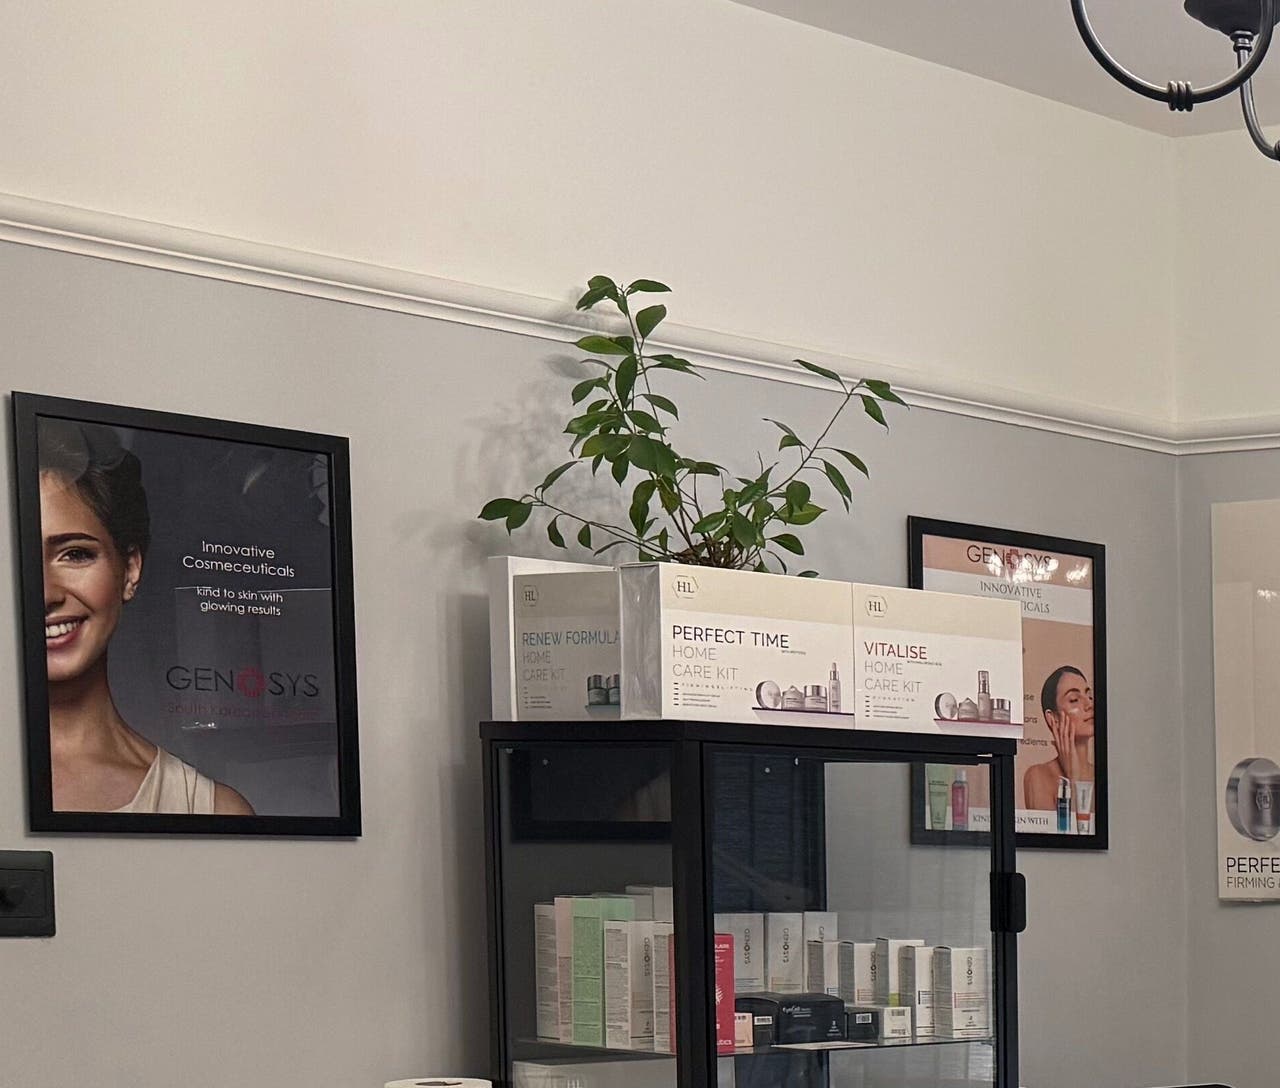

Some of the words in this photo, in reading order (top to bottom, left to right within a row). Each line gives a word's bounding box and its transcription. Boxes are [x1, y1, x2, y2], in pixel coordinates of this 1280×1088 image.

[202, 541, 275, 559] Innovative
[182, 555, 295, 577] Cosmeceuticals
[676, 580, 695, 593] HL
[980, 580, 1042, 599] INNOVATIVE
[196, 586, 220, 598] kind
[224, 588, 235, 598] to
[238, 590, 257, 600] skin
[261, 592, 283, 603] with
[524, 590, 537, 601] HL
[200, 601, 245, 616] glowing
[248, 605, 281, 616] results
[868, 600, 885, 612] HL
[522, 632, 562, 646] RENEW
[673, 625, 745, 644] PERFECT
[751, 631, 789, 648] TIME
[523, 650, 551, 664] HOME
[672, 645, 717, 661] HOME
[864, 641, 928, 660] VITALISE
[522, 668, 549, 681] CARE
[551, 668, 566, 680] KIT
[672, 663, 711, 679] CARE
[716, 666, 738, 680] KIT
[864, 661, 903, 675] HOME
[166, 665, 319, 698] GENOSYS
[864, 678, 899, 692] CARE
[903, 681, 923, 693] KIT
[1227, 876, 1275, 889] FIRMING
